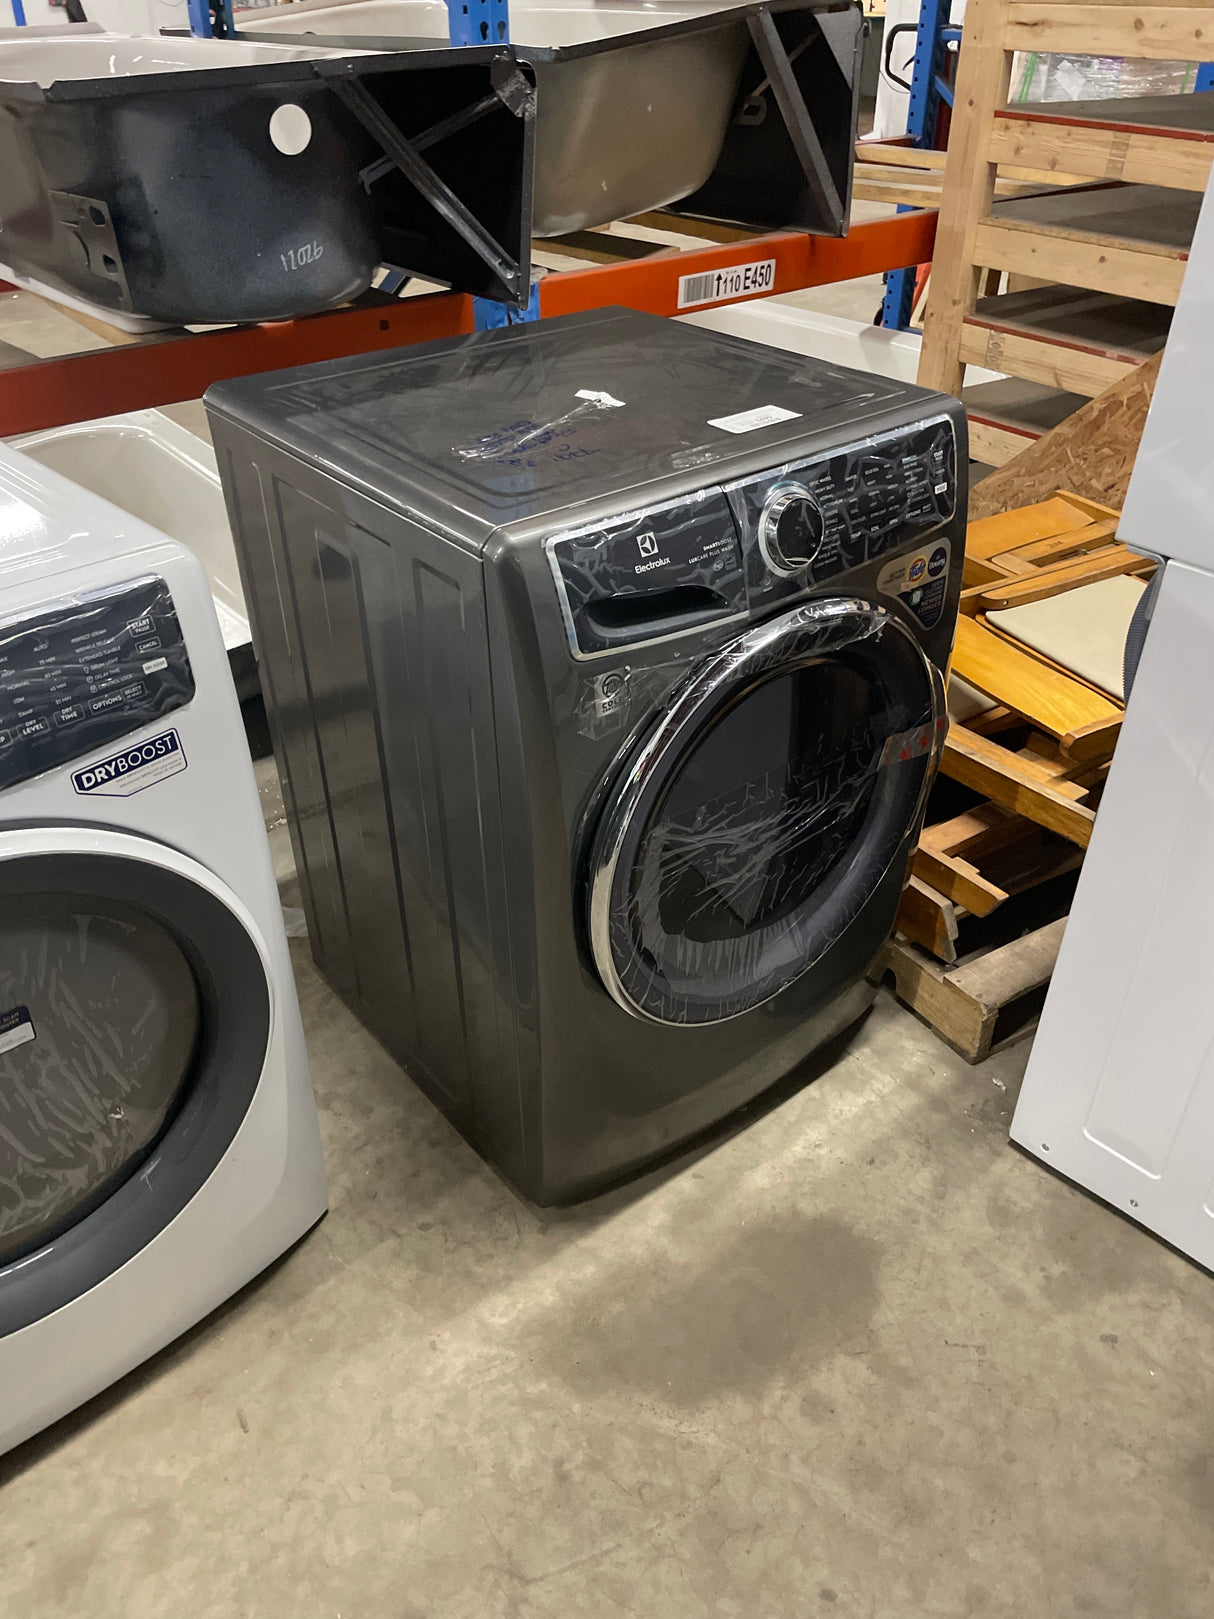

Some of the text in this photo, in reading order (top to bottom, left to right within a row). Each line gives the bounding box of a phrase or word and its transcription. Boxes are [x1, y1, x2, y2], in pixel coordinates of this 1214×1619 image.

[722, 264, 772, 294] 110 E450
[634, 557, 671, 574] Electrolux
[132, 618, 150, 628] START
[140, 640, 158, 650] CANCEL
[94, 671, 108, 680] DELAY
[124, 686, 142, 694] SELECT
[92, 694, 122, 710] OPTIONS
[61, 706, 72, 714] DRY
[61, 710, 78, 721] TIME
[22, 723, 44, 735] LEVEL
[81, 736, 172, 788] DRYBOOST
